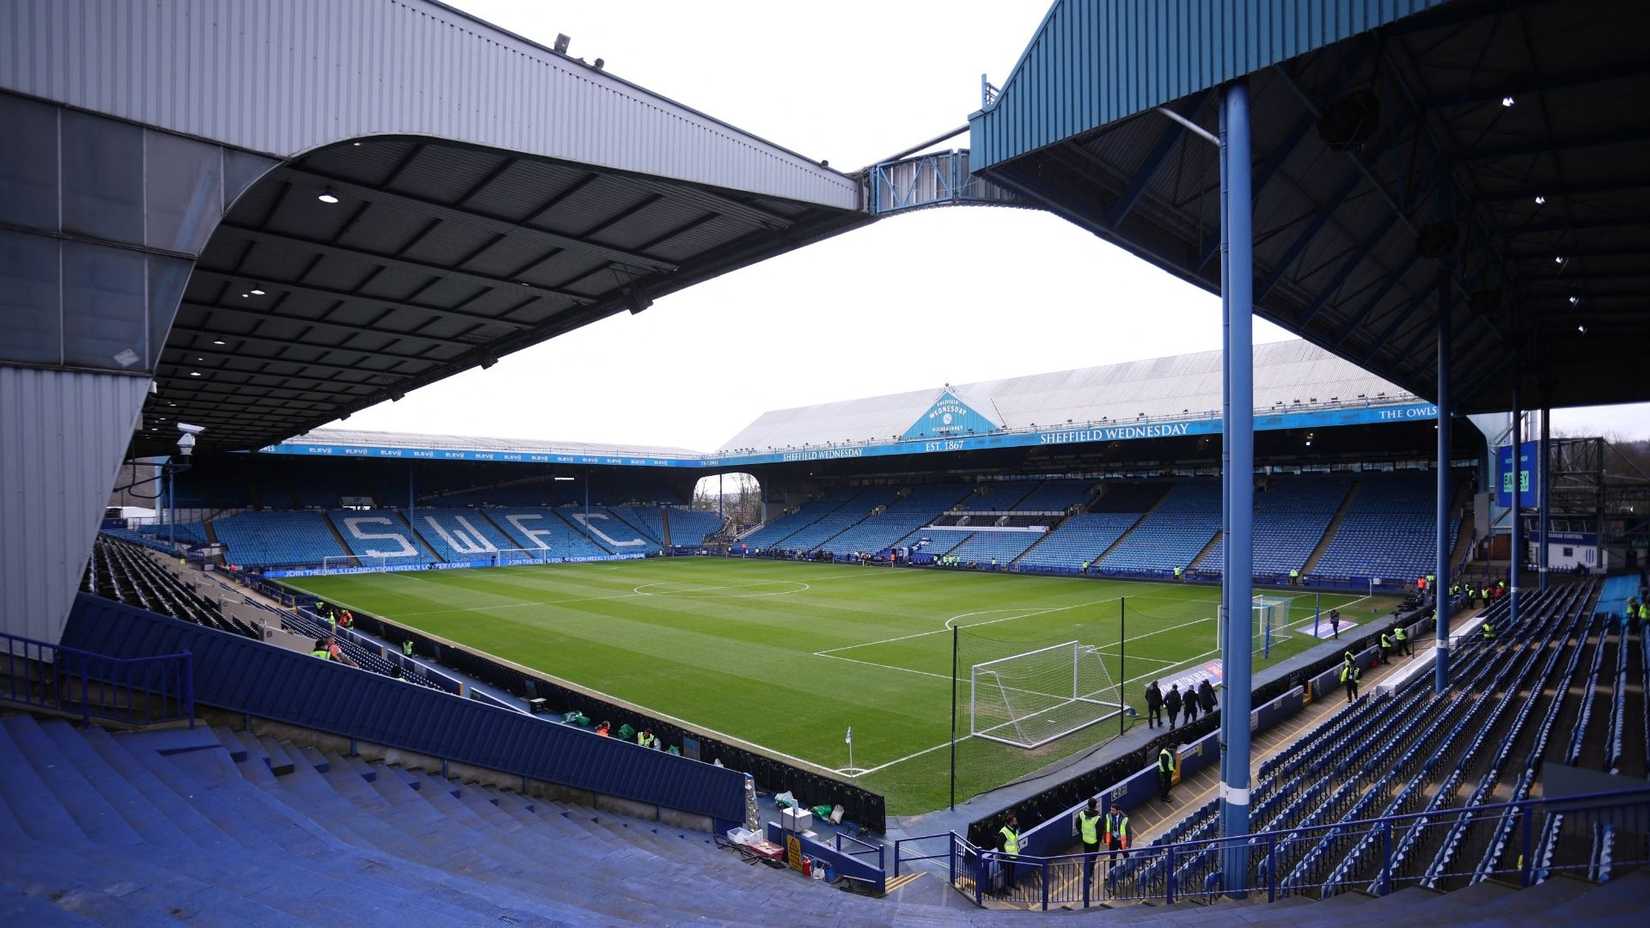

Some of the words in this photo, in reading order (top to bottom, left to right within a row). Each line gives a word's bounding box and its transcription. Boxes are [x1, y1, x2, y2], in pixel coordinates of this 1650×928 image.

[1378, 410, 1405, 419] THE
[1406, 406, 1437, 418] OWLS
[1039, 430, 1102, 445] SHEFFIELD
[1105, 423, 1189, 440] WEDNESDAY
[926, 442, 943, 452] EST.
[945, 440, 964, 450] 1867
[783, 451, 817, 462] SHEFFIELD
[819, 448, 864, 460] WEDNESDAY
[286, 570, 304, 578] JOIN
[305, 569, 321, 577] THE
